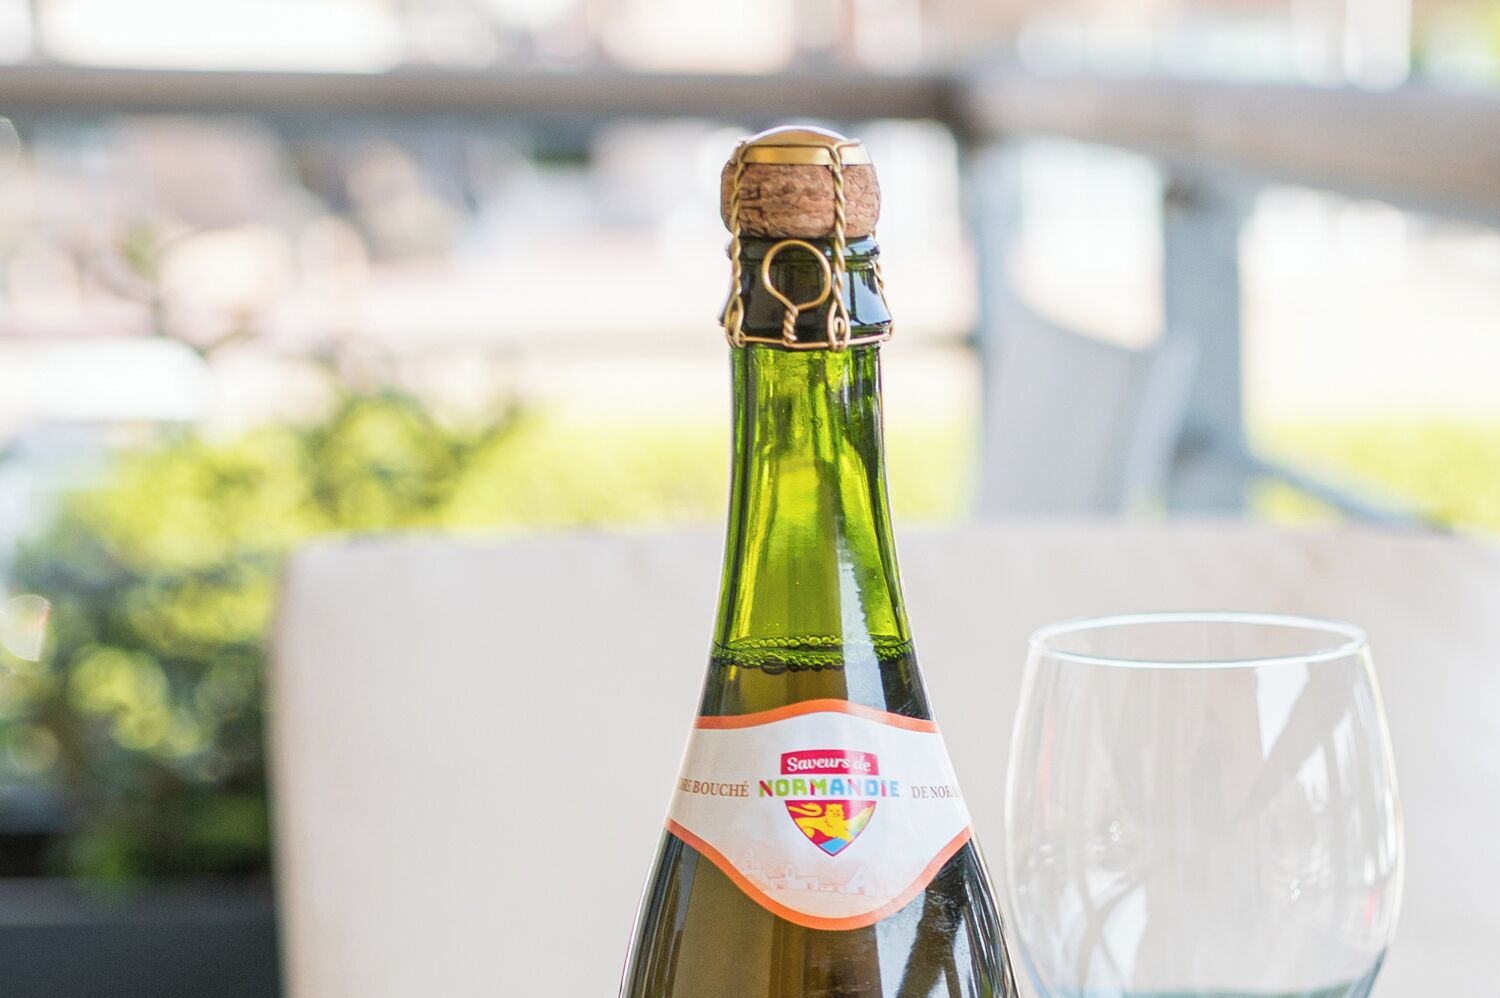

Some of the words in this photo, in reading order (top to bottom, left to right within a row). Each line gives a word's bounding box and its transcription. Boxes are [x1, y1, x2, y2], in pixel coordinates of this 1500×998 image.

[787, 757, 849, 772] Saveurs
[853, 756, 871, 772] de
[693, 780, 749, 797] BOUCHÉ
[758, 778, 900, 797] NORMANDIE
[911, 785, 929, 799] DE
